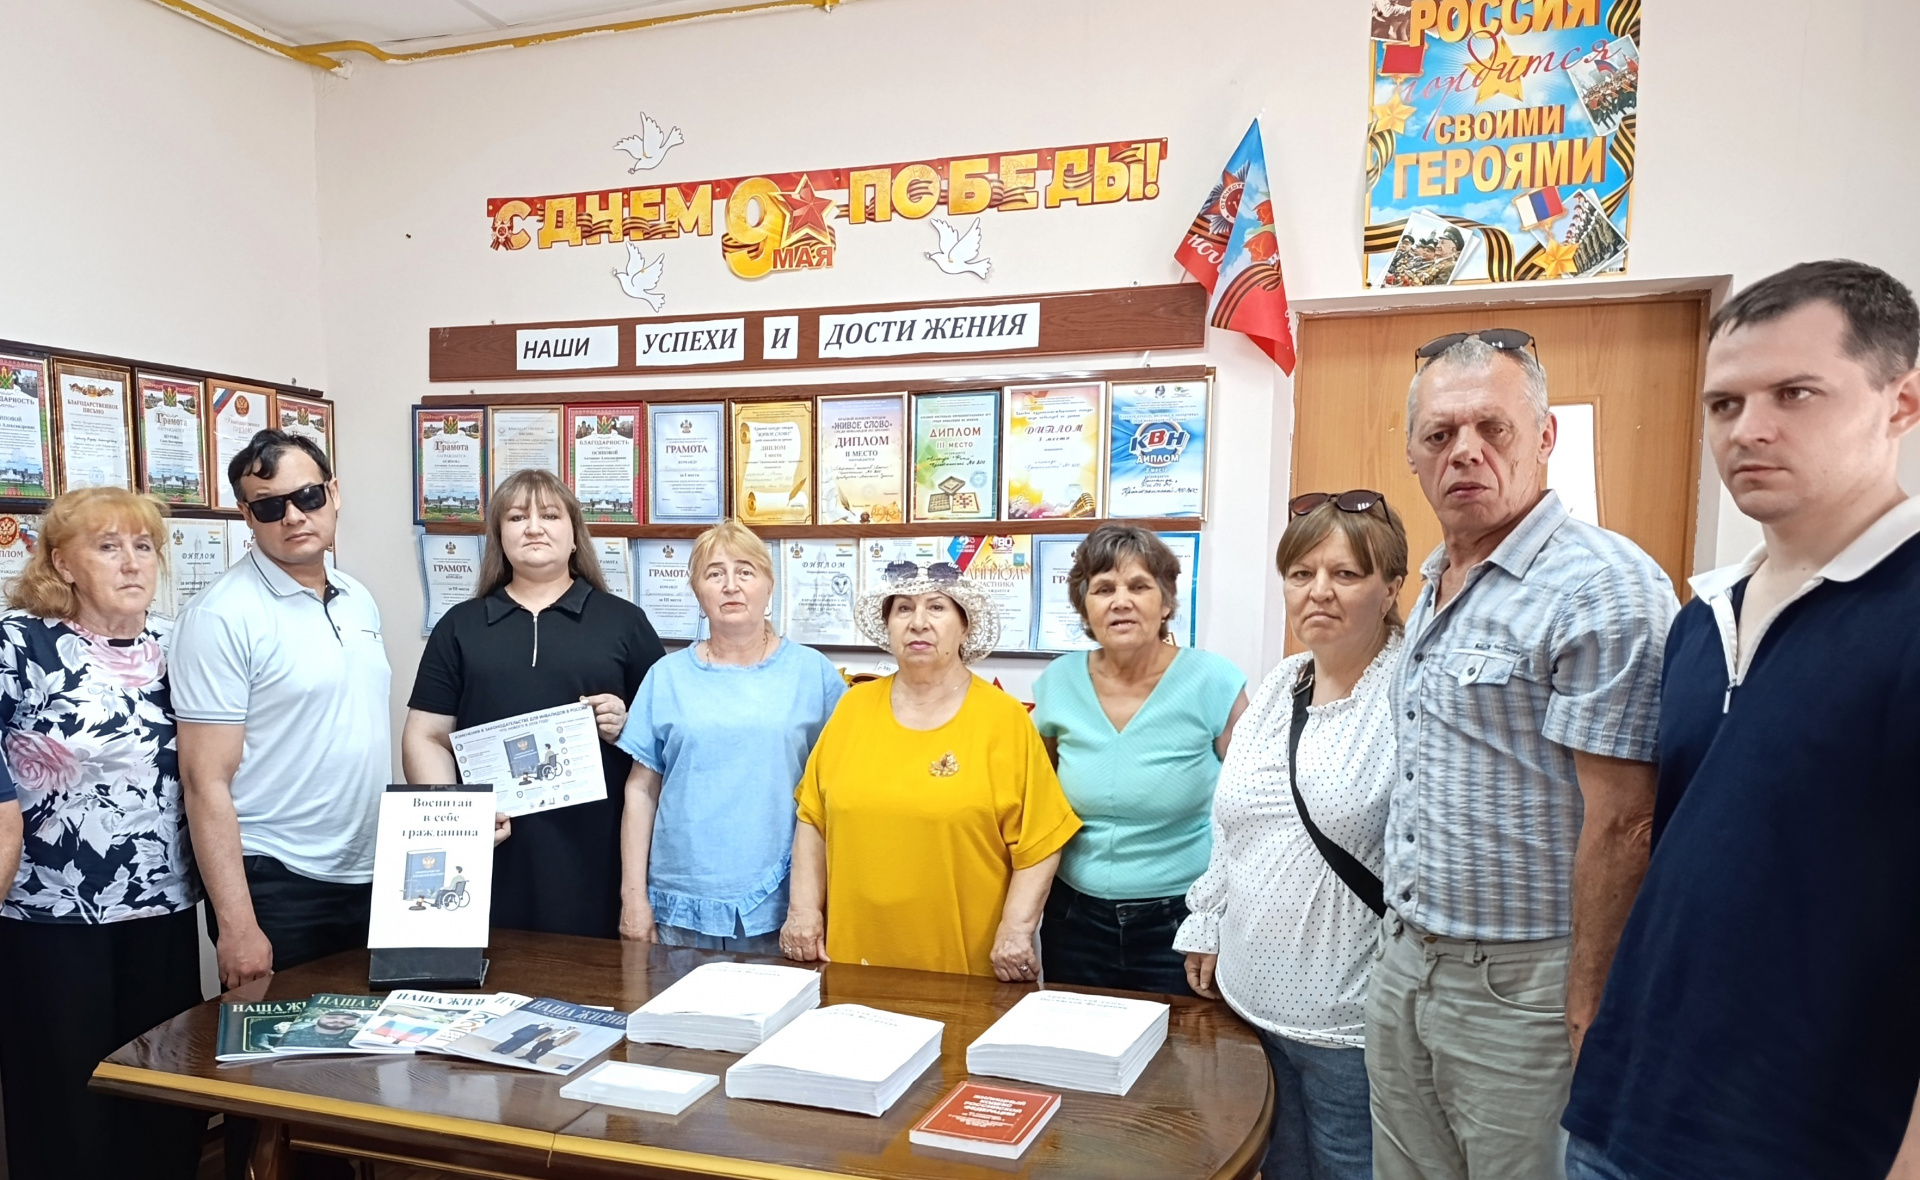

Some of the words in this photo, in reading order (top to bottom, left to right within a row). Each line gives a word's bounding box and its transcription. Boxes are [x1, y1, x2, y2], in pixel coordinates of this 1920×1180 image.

[1410, 0, 1601, 47] РОССИЯ
[1434, 104, 1565, 145] СВОИМИ
[1393, 136, 1607, 199] ГЕРОЯМИ
[491, 200, 532, 250] С
[724, 176, 784, 278] 9
[773, 246, 833, 270] МАЯ
[523, 337, 590, 359] НАШИ
[643, 328, 738, 354] УСПЕХИ
[771, 327, 791, 349] И
[929, 426, 982, 438] ДИПЛОМ
[1025, 424, 1084, 435] ДИПЛОМ
[434, 440, 469, 453] Грамота
[835, 436, 889, 449] ДИПЛОМ
[1130, 429, 1186, 452] КВН
[665, 444, 709, 454] ГРАМОТА
[1136, 454, 1179, 464] ДИПЛОМ
[433, 564, 473, 574] ГРАМОТА
[802, 561, 846, 569] ДИПЛОМ
[649, 569, 691, 578] ГРАМОТА
[413, 798, 472, 808] Воспитай
[434, 812, 460, 822] себе
[402, 829, 479, 840] гражданина
[317, 996, 366, 1008] НАША
[394, 992, 443, 1007] НАША
[232, 1003, 283, 1013] НАША
[529, 1000, 577, 1017] НАША
[573, 1009, 627, 1026] ЖИЗНЬ
